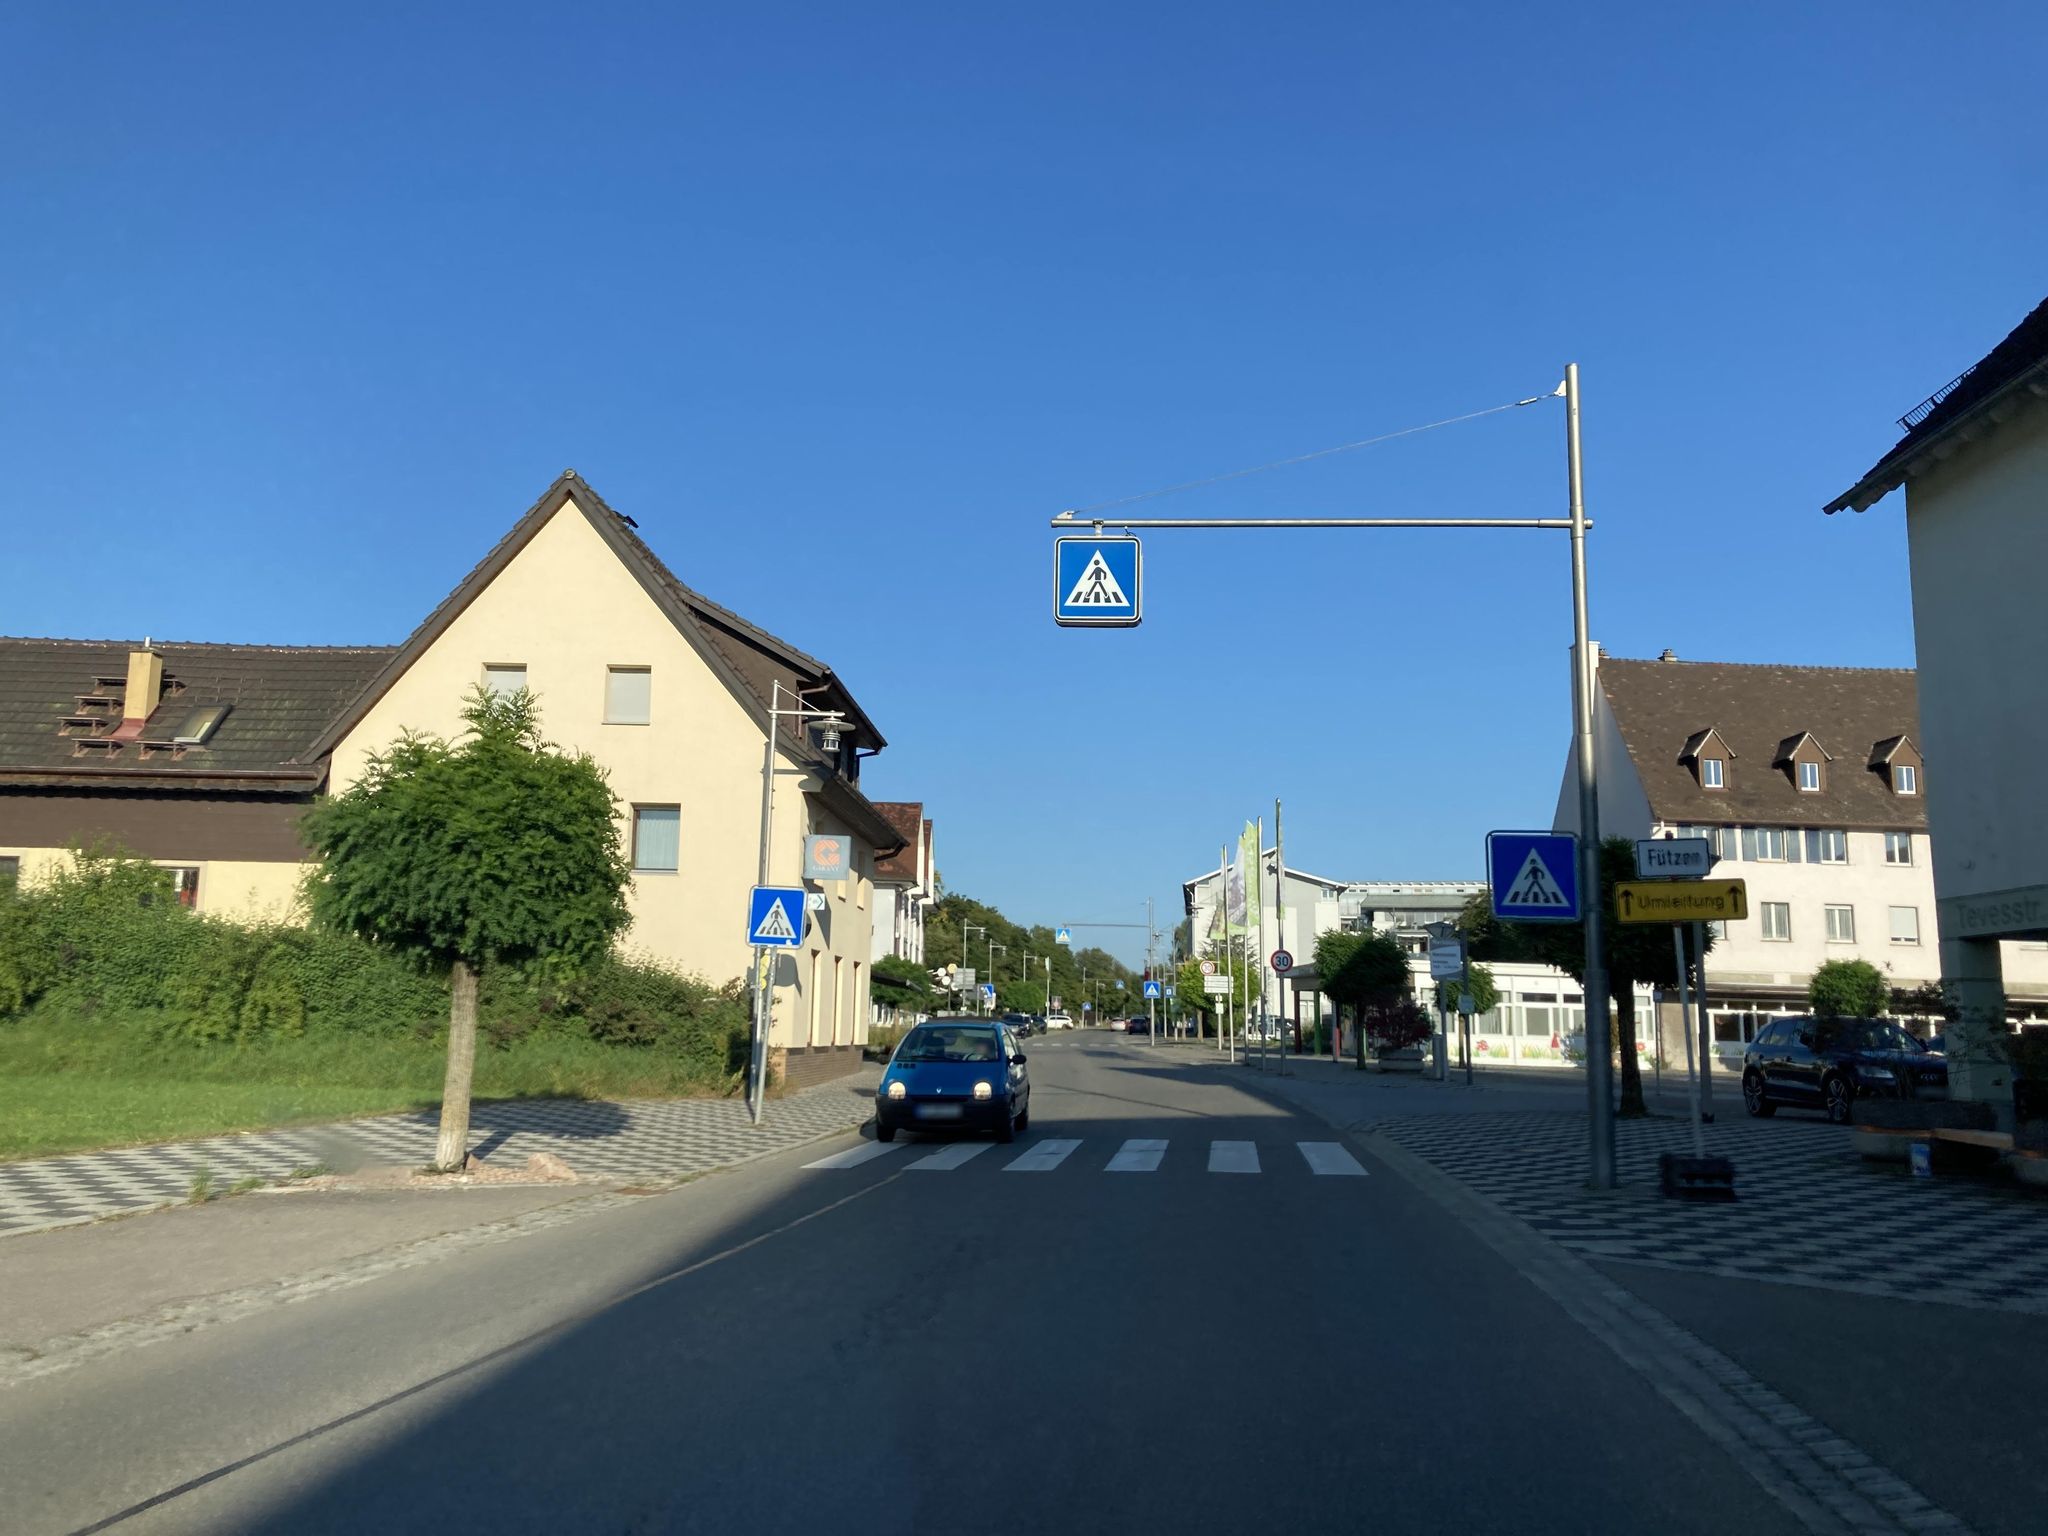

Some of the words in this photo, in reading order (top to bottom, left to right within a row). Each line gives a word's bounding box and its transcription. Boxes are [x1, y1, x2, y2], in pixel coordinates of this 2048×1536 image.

[1648, 849, 1701, 866] Fützen
[1638, 894, 1725, 912] Umleitung
[1276, 956, 1289, 967] 30
